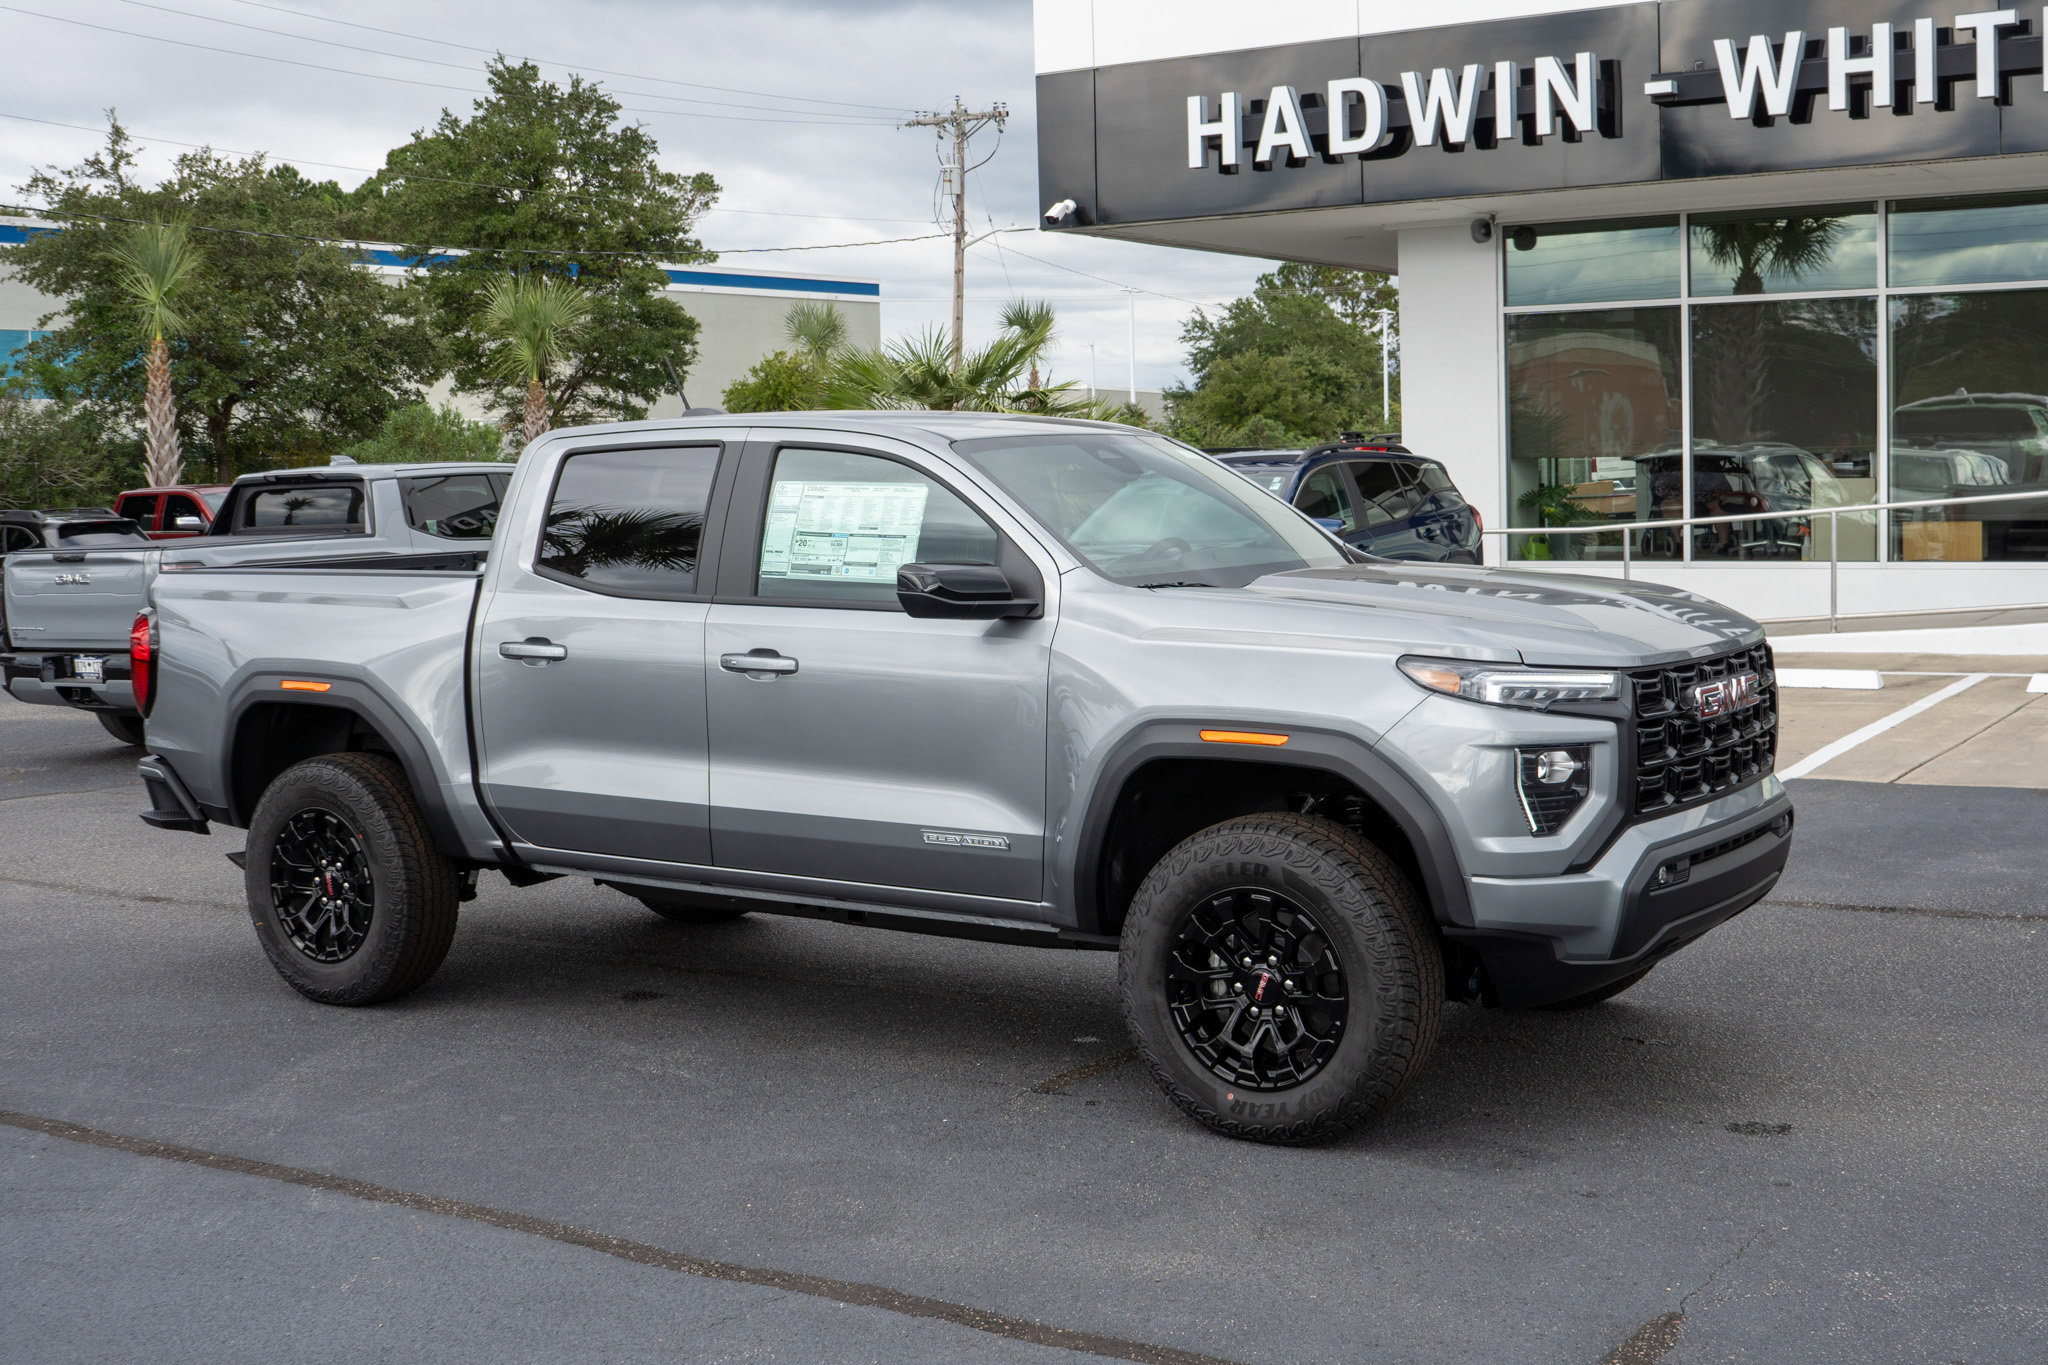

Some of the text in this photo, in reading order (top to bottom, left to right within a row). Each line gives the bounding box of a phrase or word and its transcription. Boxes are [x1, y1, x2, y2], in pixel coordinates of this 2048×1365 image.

[1187, 52, 1599, 170] HADWIN
[1713, 6, 2048, 120] WHIT
[55, 574, 90, 585] GMC
[1695, 674, 1760, 720] GMC
[926, 834, 1006, 848] ELEVATION
